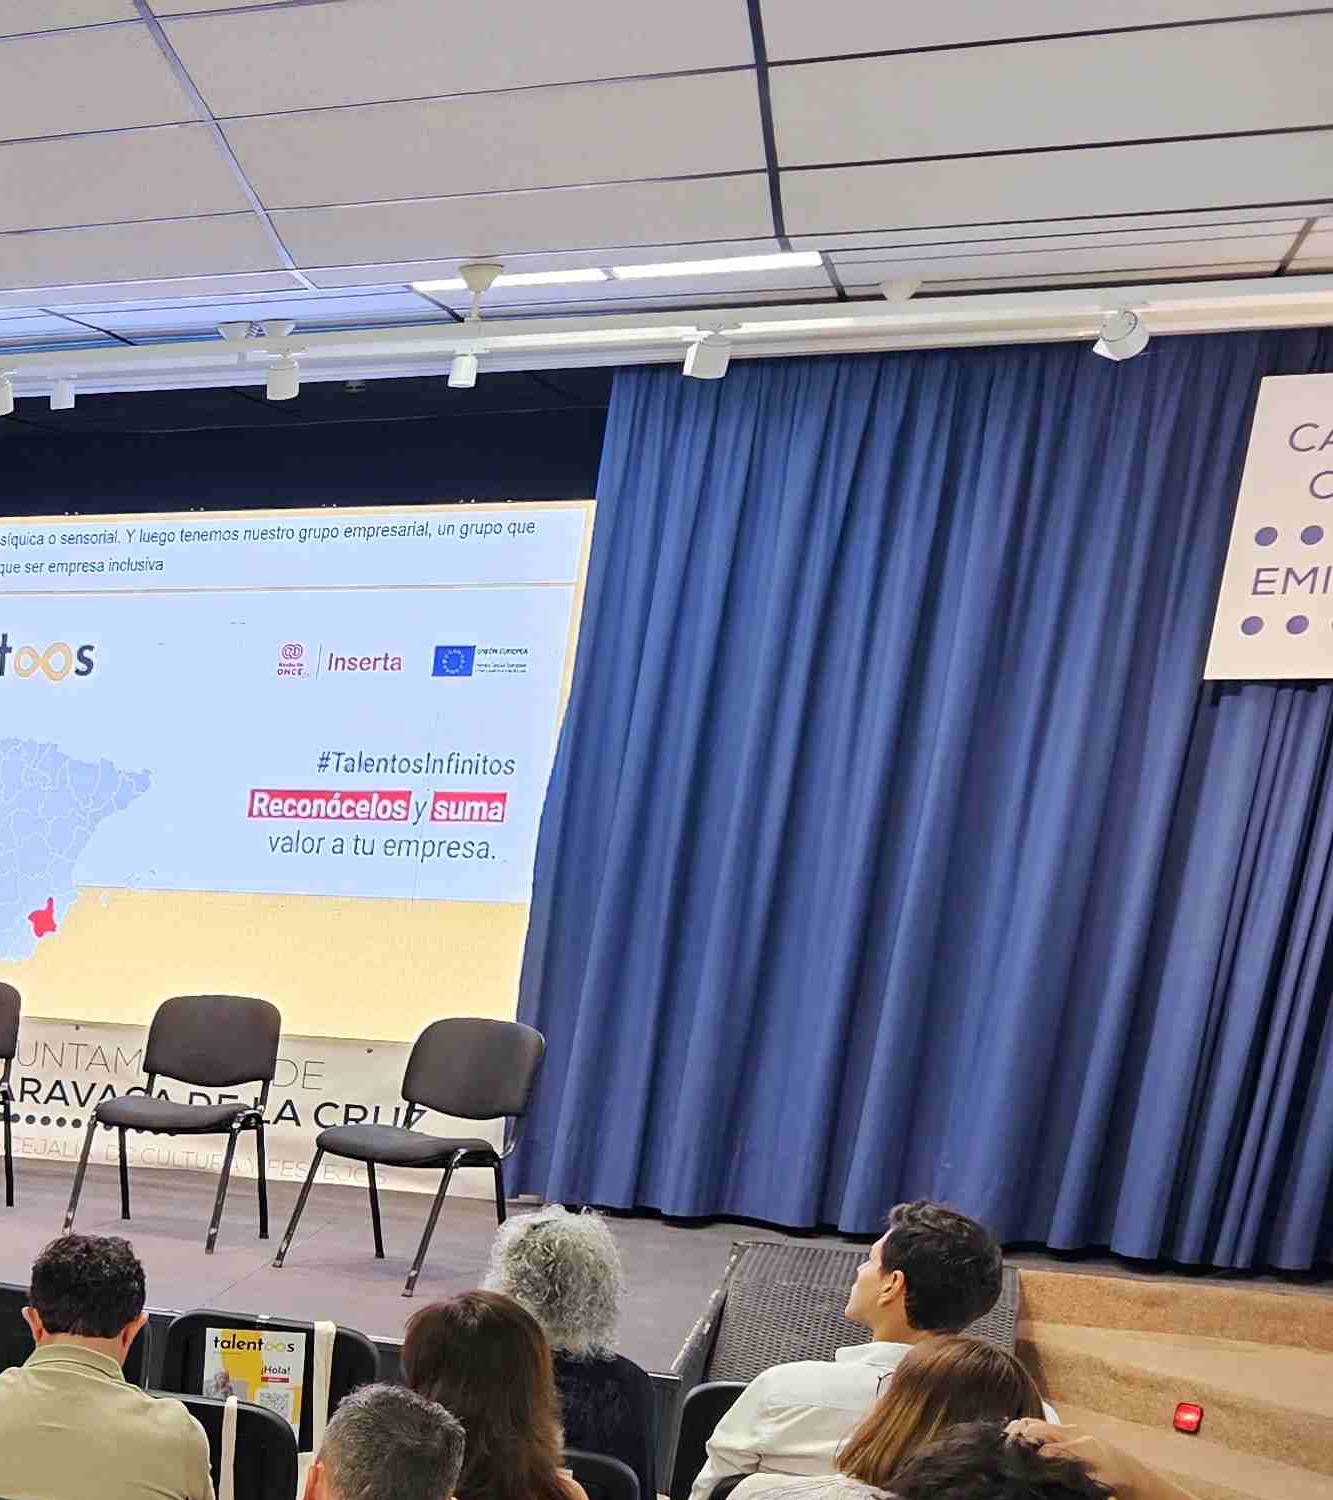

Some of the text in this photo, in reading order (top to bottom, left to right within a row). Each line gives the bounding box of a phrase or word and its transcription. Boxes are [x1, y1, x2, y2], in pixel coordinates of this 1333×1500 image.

[48, 534, 56, 545] o
[60, 530, 121, 545] sensorial.
[126, 529, 136, 543] Y
[139, 528, 176, 545] luego
[180, 526, 239, 543] tenemos
[243, 526, 294, 541] nuestro
[298, 526, 339, 543] grupo
[344, 521, 432, 541] empresarial,
[438, 522, 455, 536] un
[459, 521, 502, 539] grupo
[507, 520, 535, 536] que
[25, 562, 44, 574] ser
[48, 560, 104, 576] empresa
[108, 555, 164, 572] inclusiva
[328, 652, 402, 672] Inserta
[317, 750, 516, 776] #TalentosInfinitos
[252, 791, 503, 826] Reconócelos y suma
[268, 830, 497, 863] valor a tu empresa.
[260, 1365, 291, 1376] ¡Hola!
